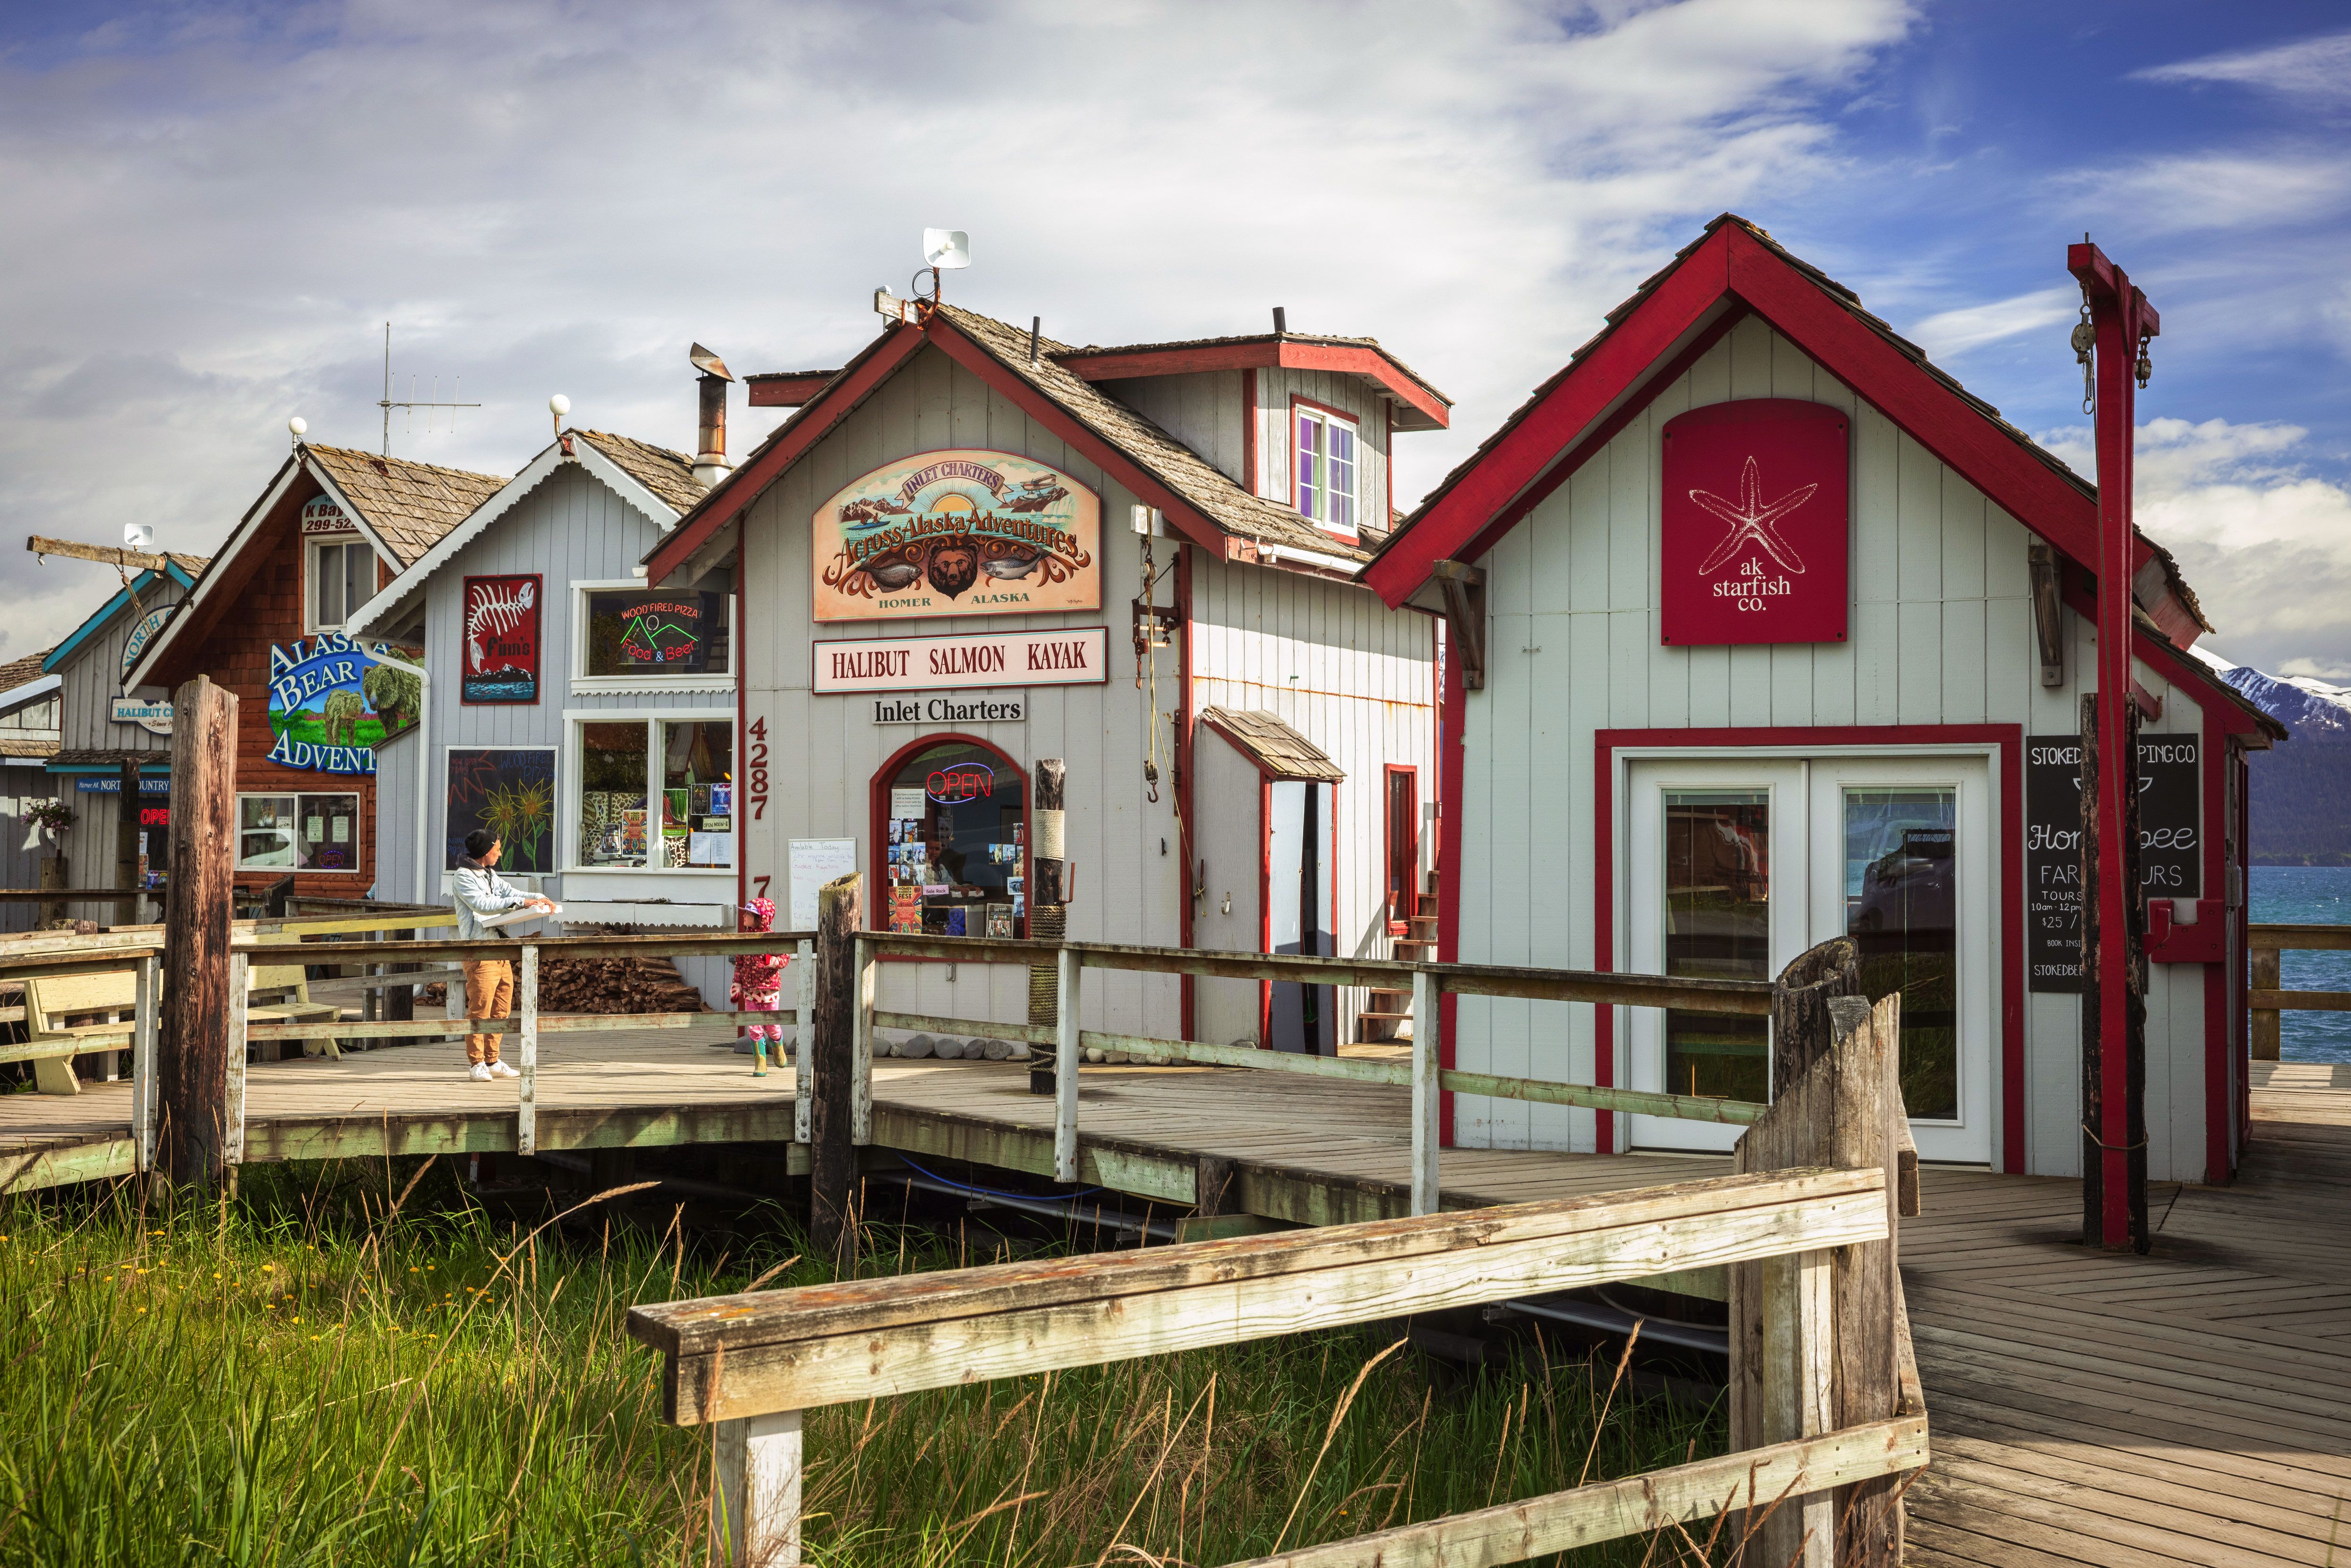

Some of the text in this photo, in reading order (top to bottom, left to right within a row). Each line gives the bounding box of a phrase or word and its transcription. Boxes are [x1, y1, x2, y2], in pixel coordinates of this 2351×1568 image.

[905, 463, 1000, 494] INLET CHARTERS
[305, 505, 316, 518] K
[827, 525, 901, 576] Across
[895, 512, 966, 543] Alaska
[1741, 556, 1764, 575] ak
[1713, 575, 1792, 597] starfish
[879, 592, 1030, 608] HOMER ALASKA
[1738, 598, 1767, 611] co.
[621, 603, 698, 620] WOOD FIRED PIZZA
[622, 638, 695, 662] Food & Beer
[832, 641, 1088, 679] HALIBUT SALMON KAYAK
[274, 661, 357, 716] BEAR
[117, 708, 161, 717] HALIBUT
[875, 699, 1021, 722] Inlet Charters
[500, 752, 526, 770] WOOD
[2031, 747, 2081, 765] STOKED
[927, 771, 991, 797] OPEN
[819, 842, 839, 853] Today
[318, 854, 345, 865] OPEN
[2041, 865, 2080, 884] FAR
[2042, 891, 2082, 901] TOURS
[2042, 917, 2062, 928] $25
